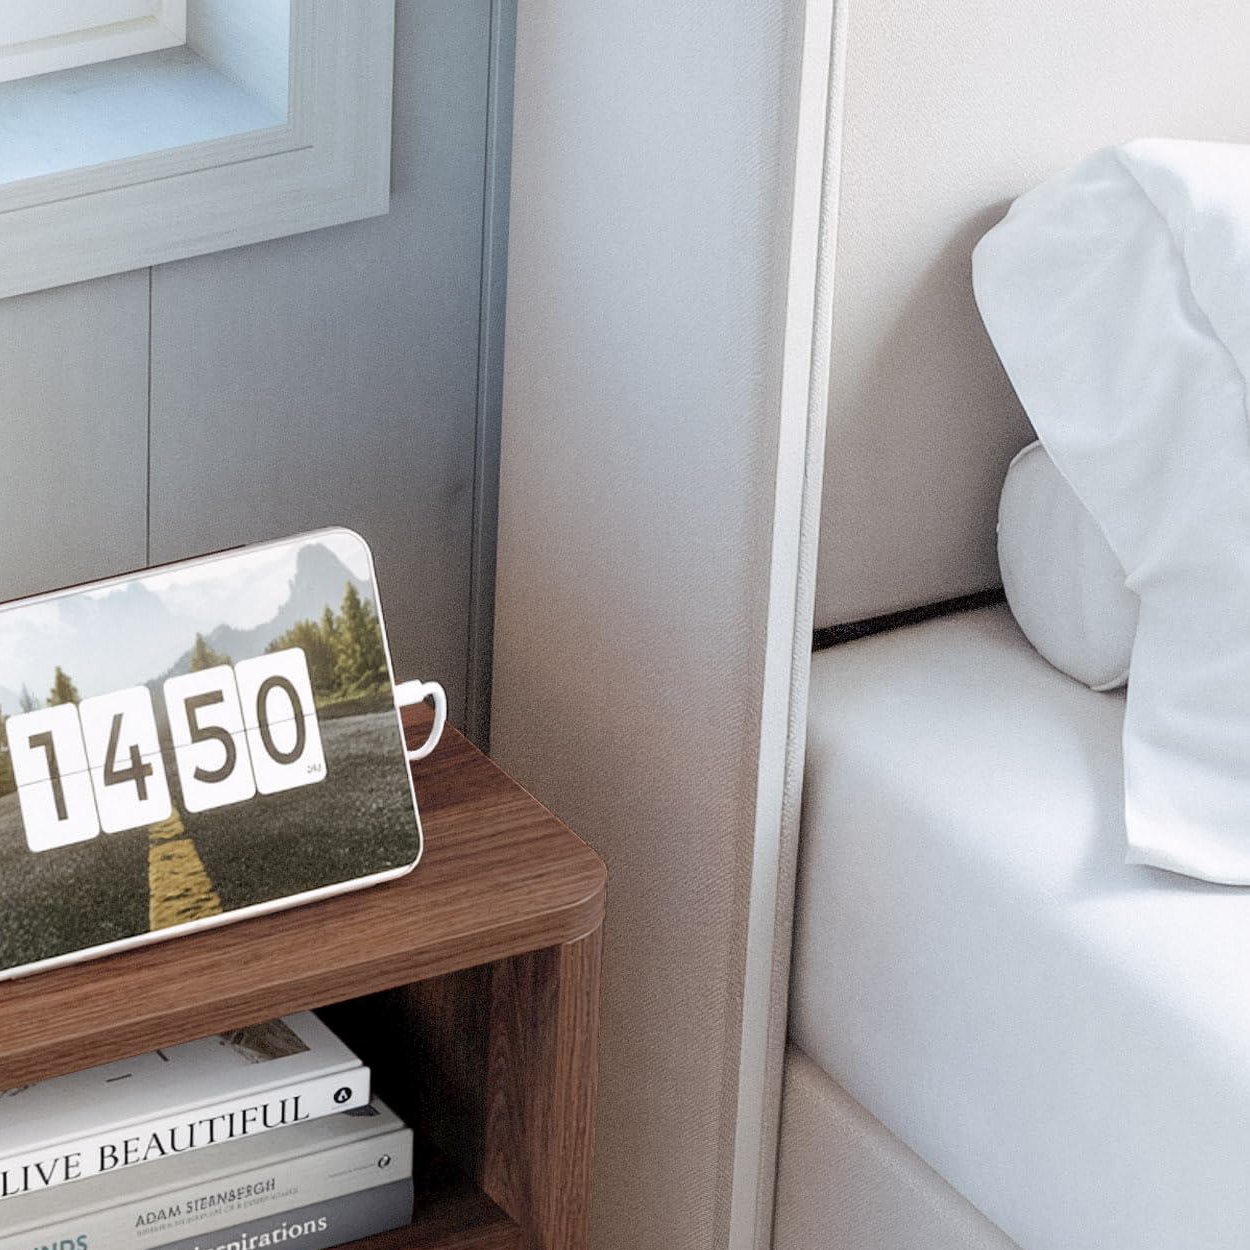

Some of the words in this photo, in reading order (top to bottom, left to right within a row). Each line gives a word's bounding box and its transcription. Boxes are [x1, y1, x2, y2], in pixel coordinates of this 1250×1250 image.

[1, 1152, 82, 1197] LIVE
[98, 1095, 310, 1172] BEAUTIFUL
[135, 1204, 182, 1228] ADAM
